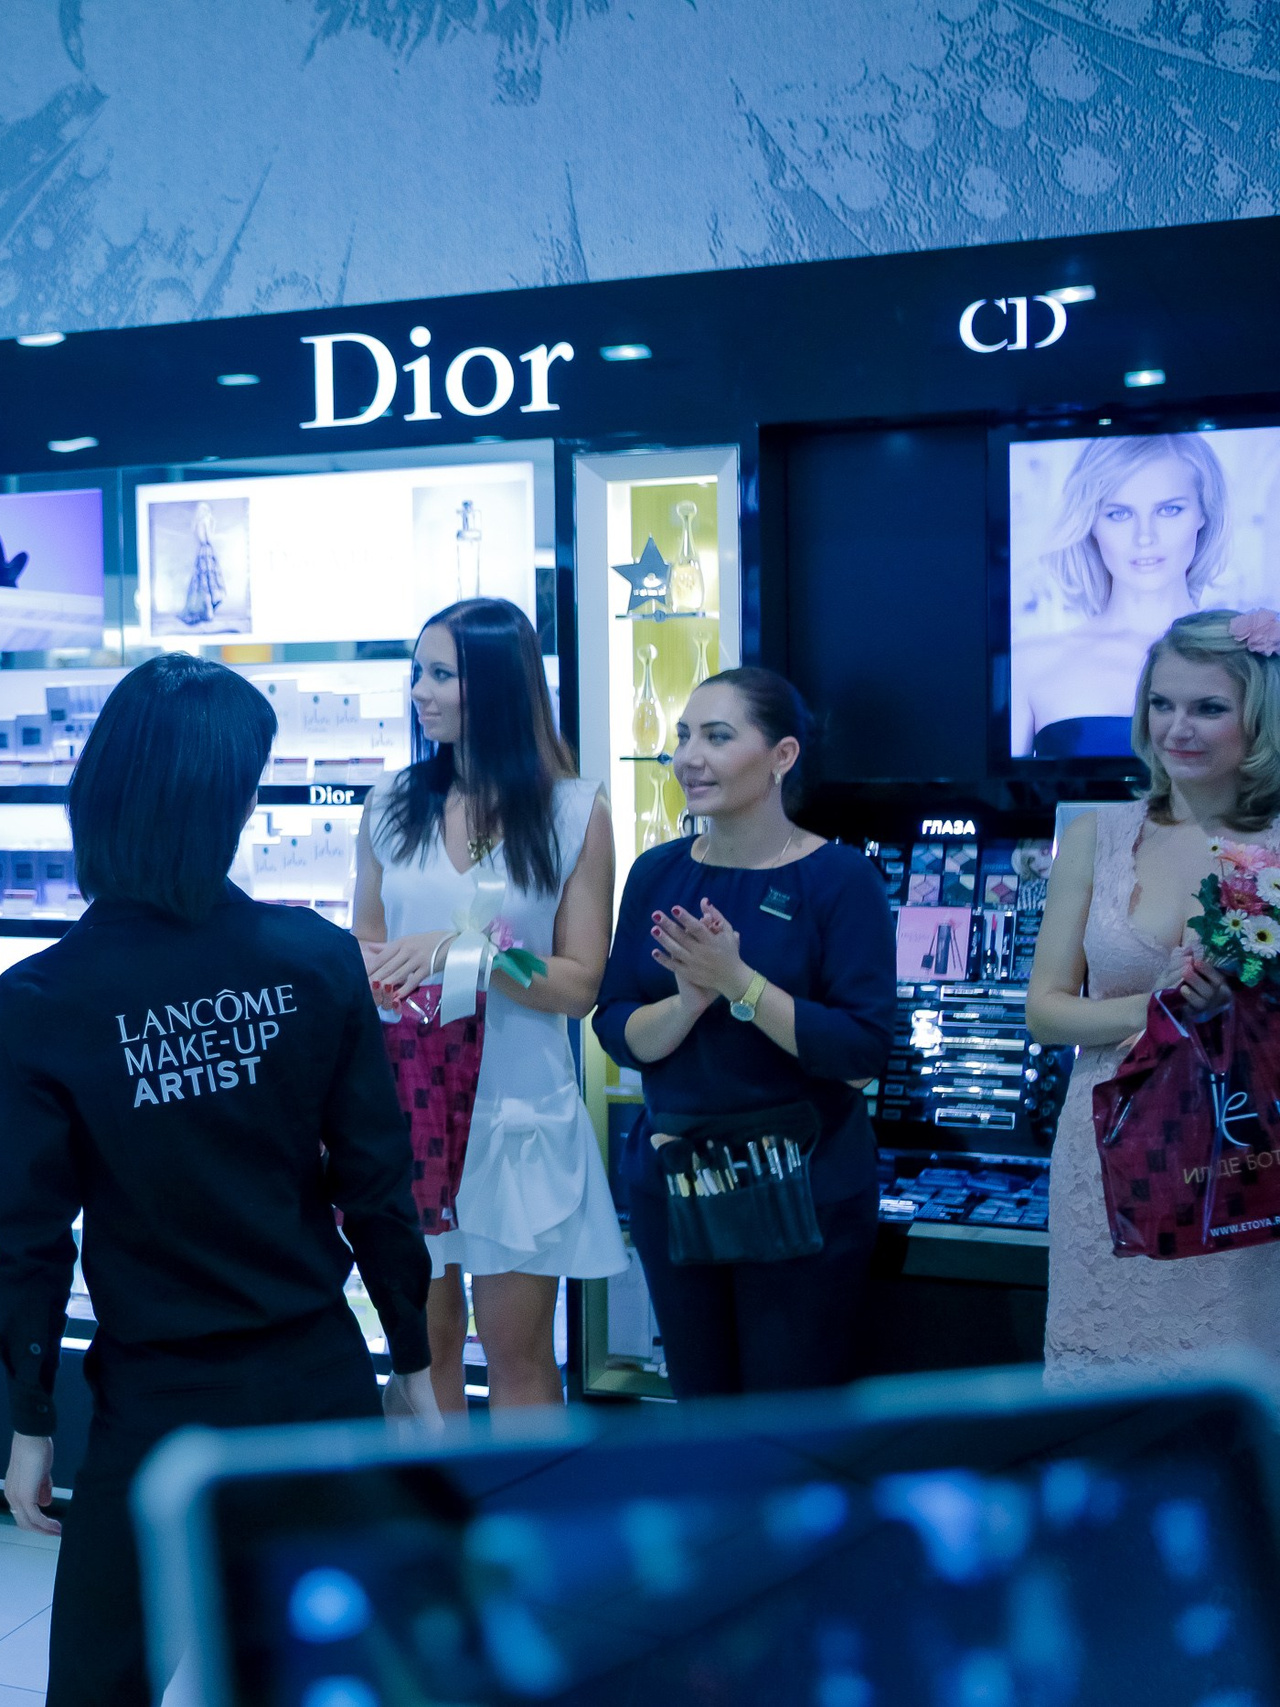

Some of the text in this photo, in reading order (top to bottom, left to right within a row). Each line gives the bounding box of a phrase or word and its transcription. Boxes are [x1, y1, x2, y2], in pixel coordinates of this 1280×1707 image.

[299, 325, 575, 430] Dior
[309, 785, 355, 805] Dior
[922, 819, 976, 835] ГЛАЗА
[115, 984, 298, 1043] LANCÔME
[124, 1020, 280, 1076] MAKE-UP
[133, 1056, 262, 1108] ARTIST
